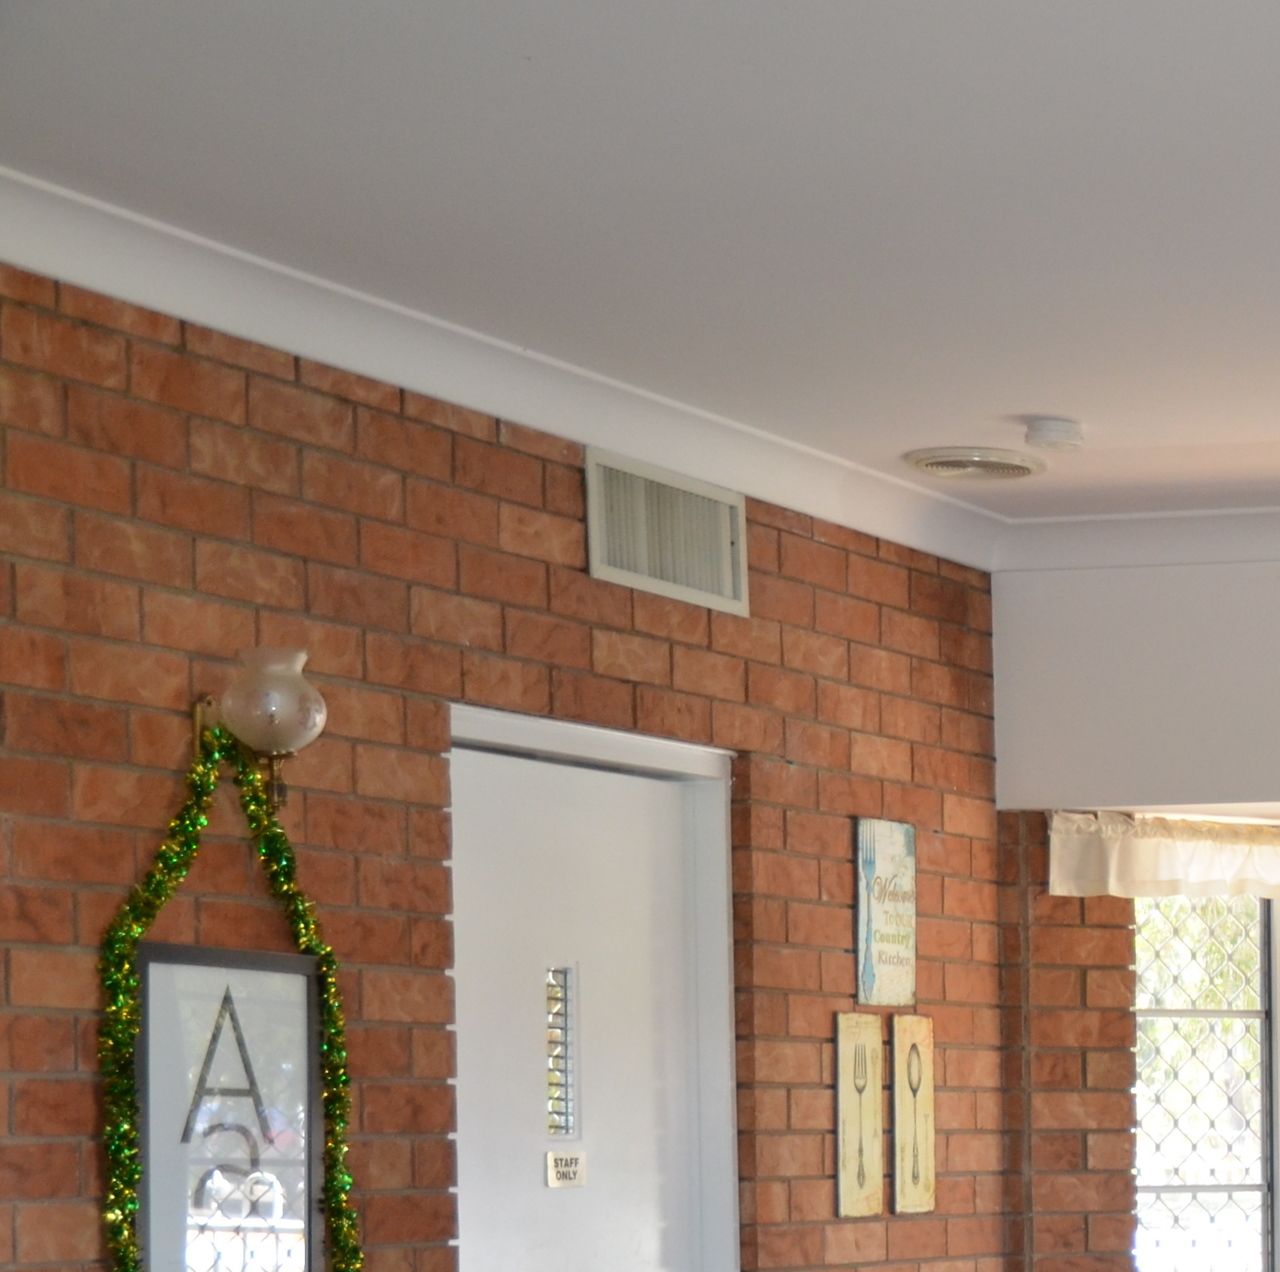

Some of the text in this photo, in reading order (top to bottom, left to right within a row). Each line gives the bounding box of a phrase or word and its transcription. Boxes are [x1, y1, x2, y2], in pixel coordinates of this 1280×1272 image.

[873, 929, 911, 949] Country
[553, 1157, 580, 1169] STAFF
[555, 1169, 578, 1181] ONLY
